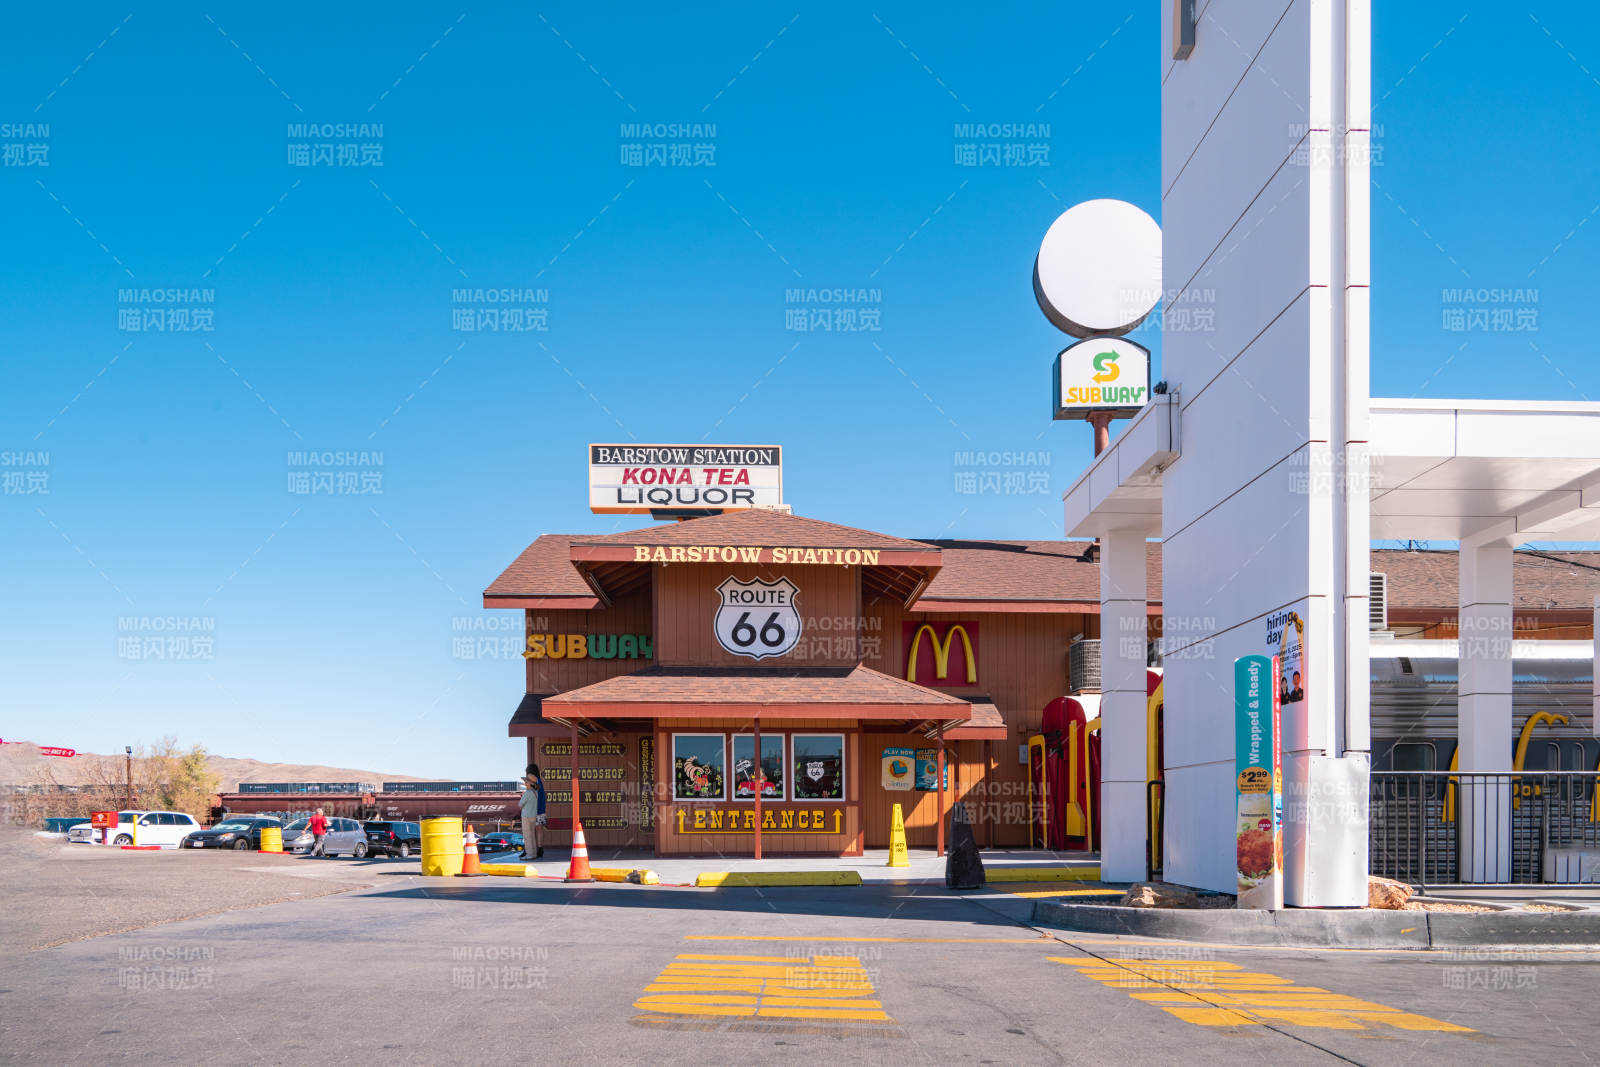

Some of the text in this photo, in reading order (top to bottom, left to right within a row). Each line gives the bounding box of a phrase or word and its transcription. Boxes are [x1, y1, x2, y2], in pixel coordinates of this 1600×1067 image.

[1065, 386, 1146, 404] SUBWAY
[597, 448, 773, 465] BARSTOW STATION
[622, 467, 751, 485] KONA TEA
[617, 488, 756, 505] LIQUOR
[633, 545, 880, 566] BARSTOW STATION
[728, 590, 786, 605] ROUTE
[730, 611, 787, 648] 66
[1266, 611, 1294, 632] hiring
[522, 633, 653, 660] SUBWAY
[1266, 630, 1283, 646] day
[1248, 660, 1263, 764] Wrapped & Ready
[545, 745, 572, 755] CANDY
[577, 745, 596, 754] RUIT
[544, 769, 599, 779] HOLLYOOD
[810, 768, 821, 777] 66
[641, 739, 649, 827] GENERAL STORE
[546, 792, 622, 802] DOUBL R GIFTS
[468, 803, 507, 811] BNSF
[585, 819, 623, 827] ICE CREAM
[694, 809, 825, 830] ENTRANCE
